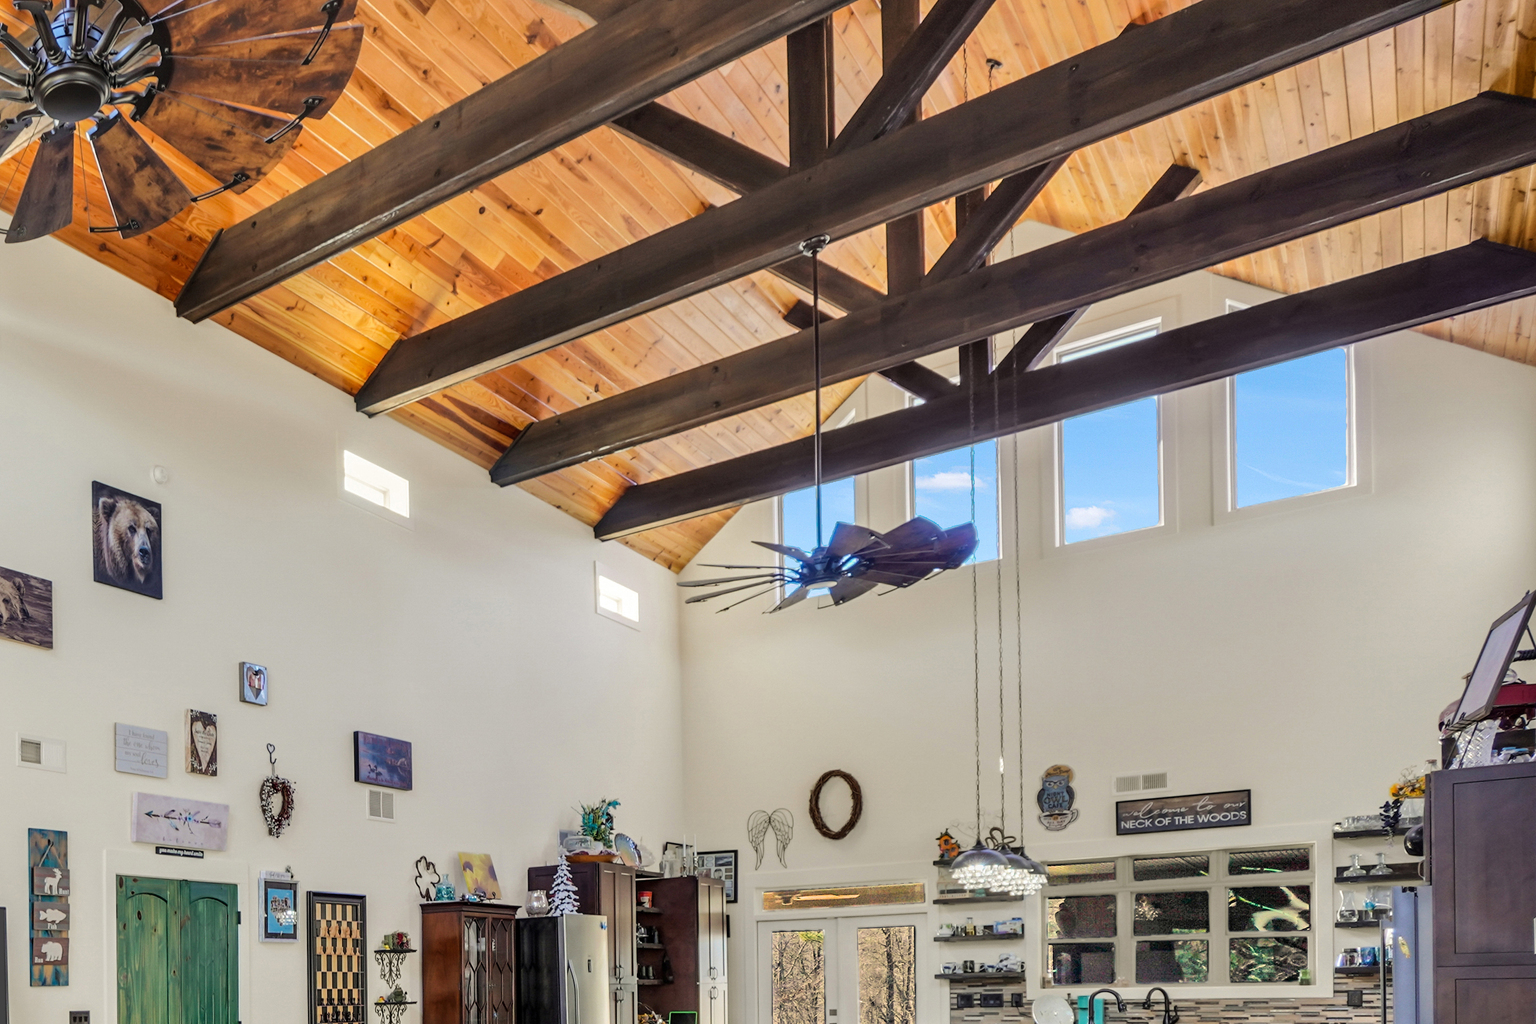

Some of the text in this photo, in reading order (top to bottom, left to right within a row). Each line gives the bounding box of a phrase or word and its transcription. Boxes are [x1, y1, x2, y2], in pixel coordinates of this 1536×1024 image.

[1044, 796, 1069, 804] OWL
[1122, 802, 1189, 819] welcome
[1192, 796, 1216, 811] to
[1120, 811, 1247, 829] NECK OF THE WOODS
